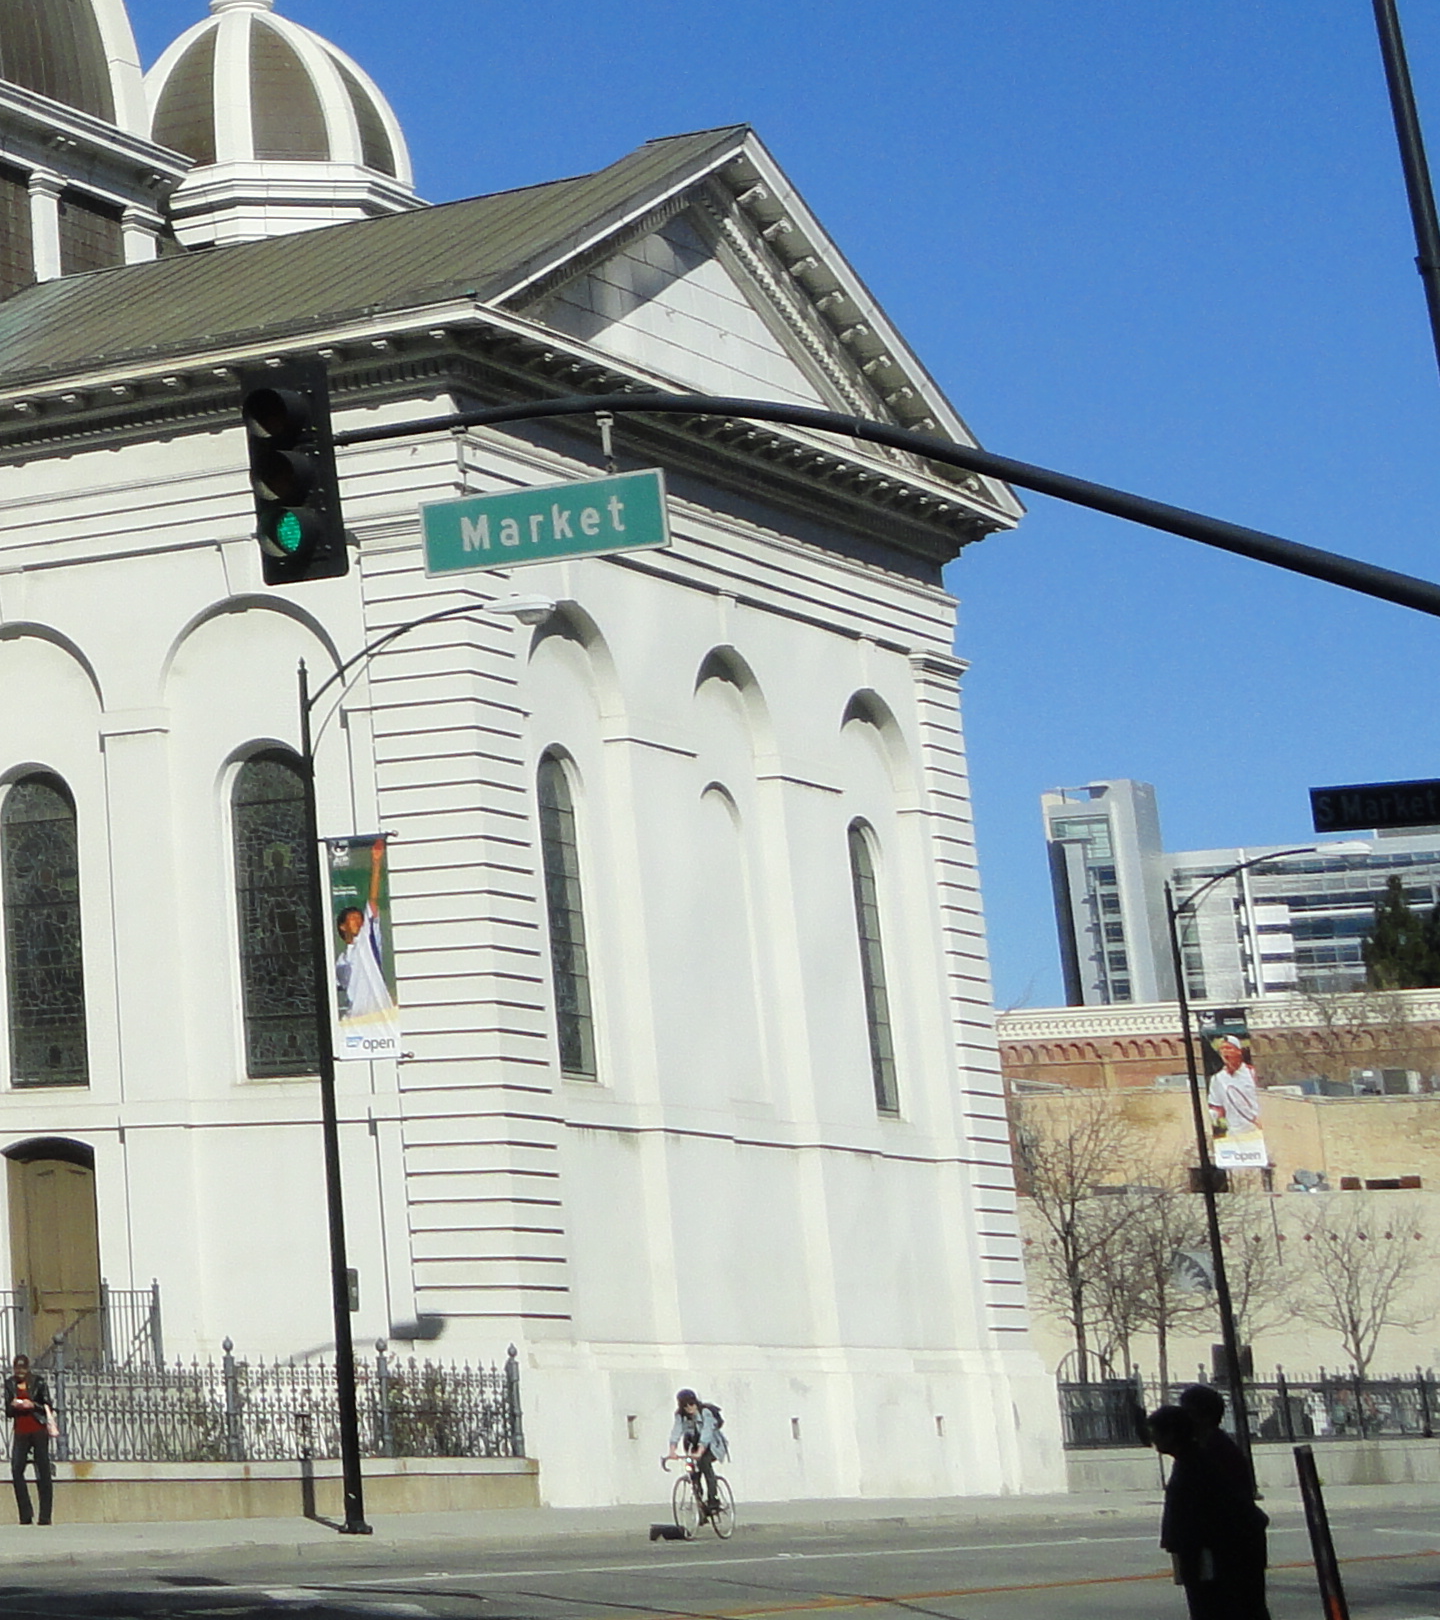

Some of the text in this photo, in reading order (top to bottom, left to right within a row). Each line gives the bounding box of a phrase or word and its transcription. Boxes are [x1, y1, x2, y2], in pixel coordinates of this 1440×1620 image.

[460, 495, 625, 552] Market
[1317, 788, 1438, 823] S Market
[362, 1037, 395, 1054] open
[1234, 1151, 1262, 1163] open
